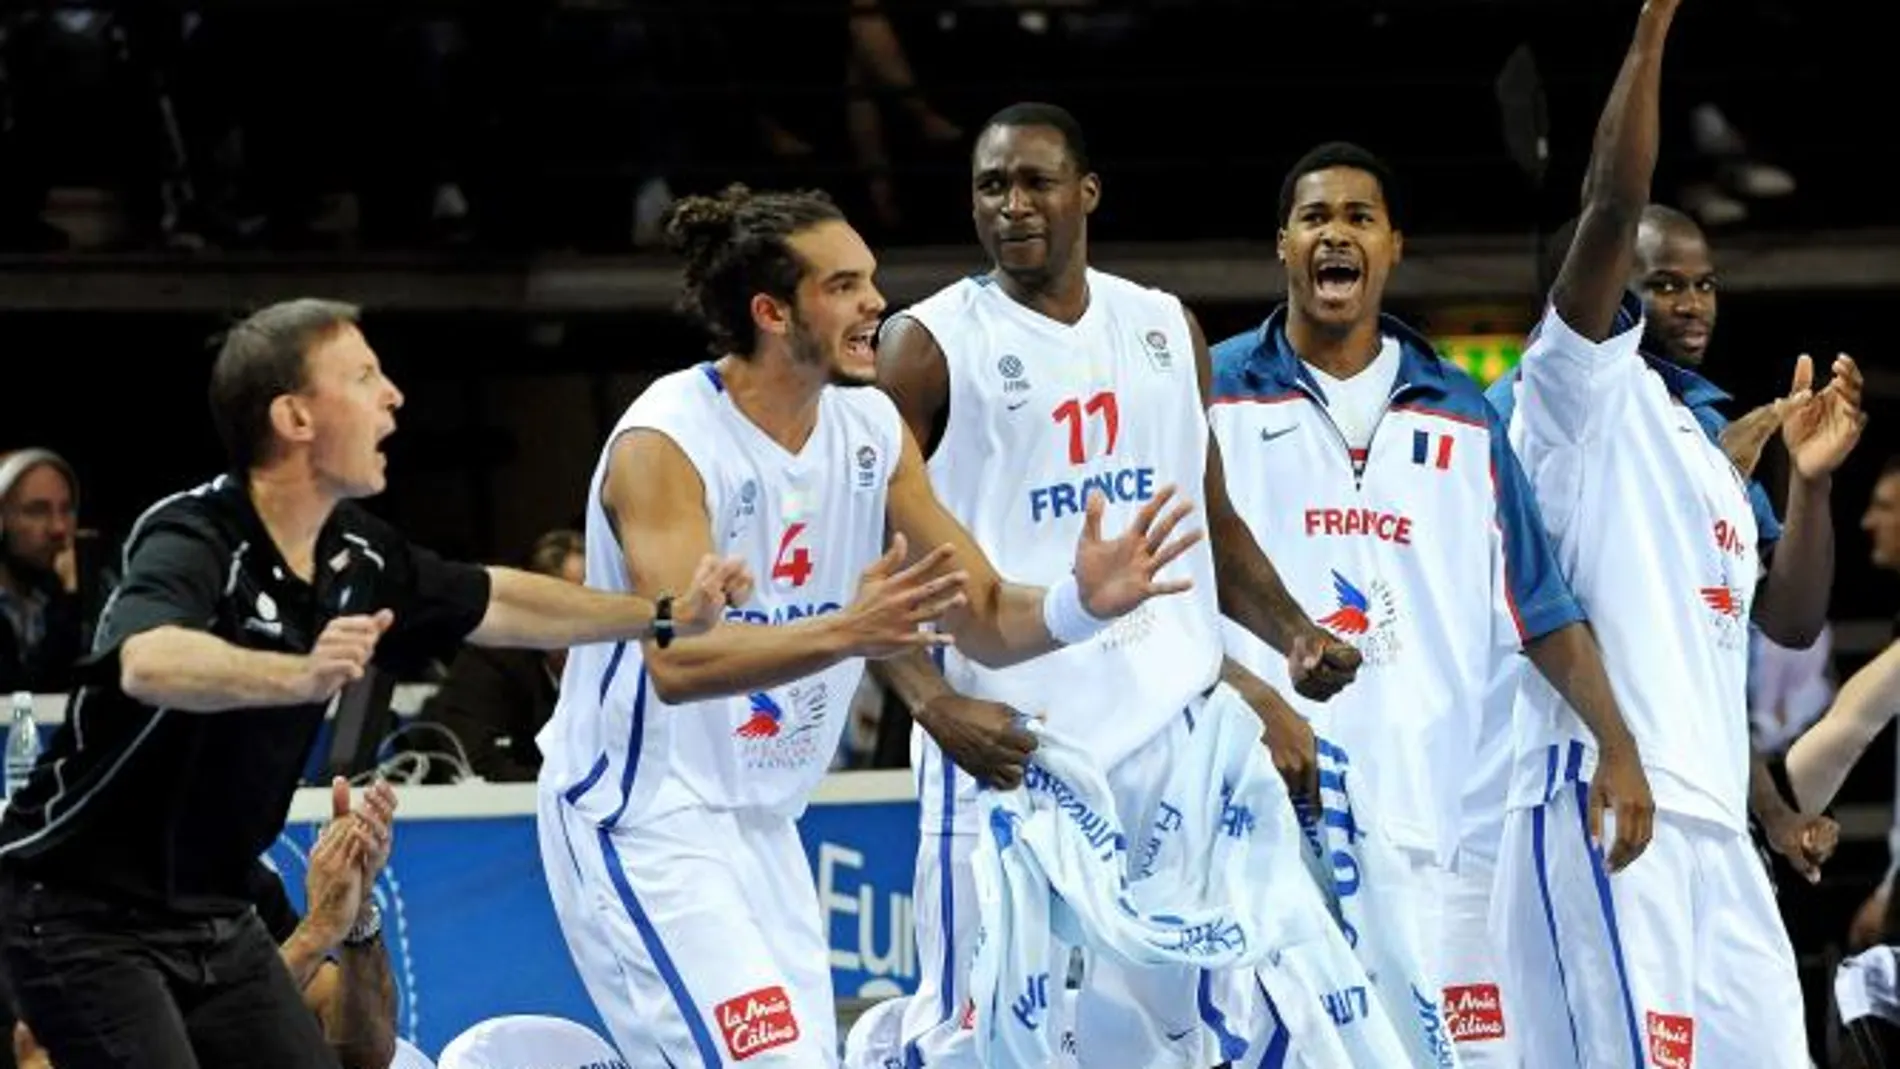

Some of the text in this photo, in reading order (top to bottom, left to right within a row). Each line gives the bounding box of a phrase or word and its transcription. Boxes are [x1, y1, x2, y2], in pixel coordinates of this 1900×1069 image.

[1051, 391, 1120, 466] 11
[1030, 468, 1155, 522] FRANCE
[772, 523, 813, 587] 4
[1304, 507, 1412, 545] FRANCE
